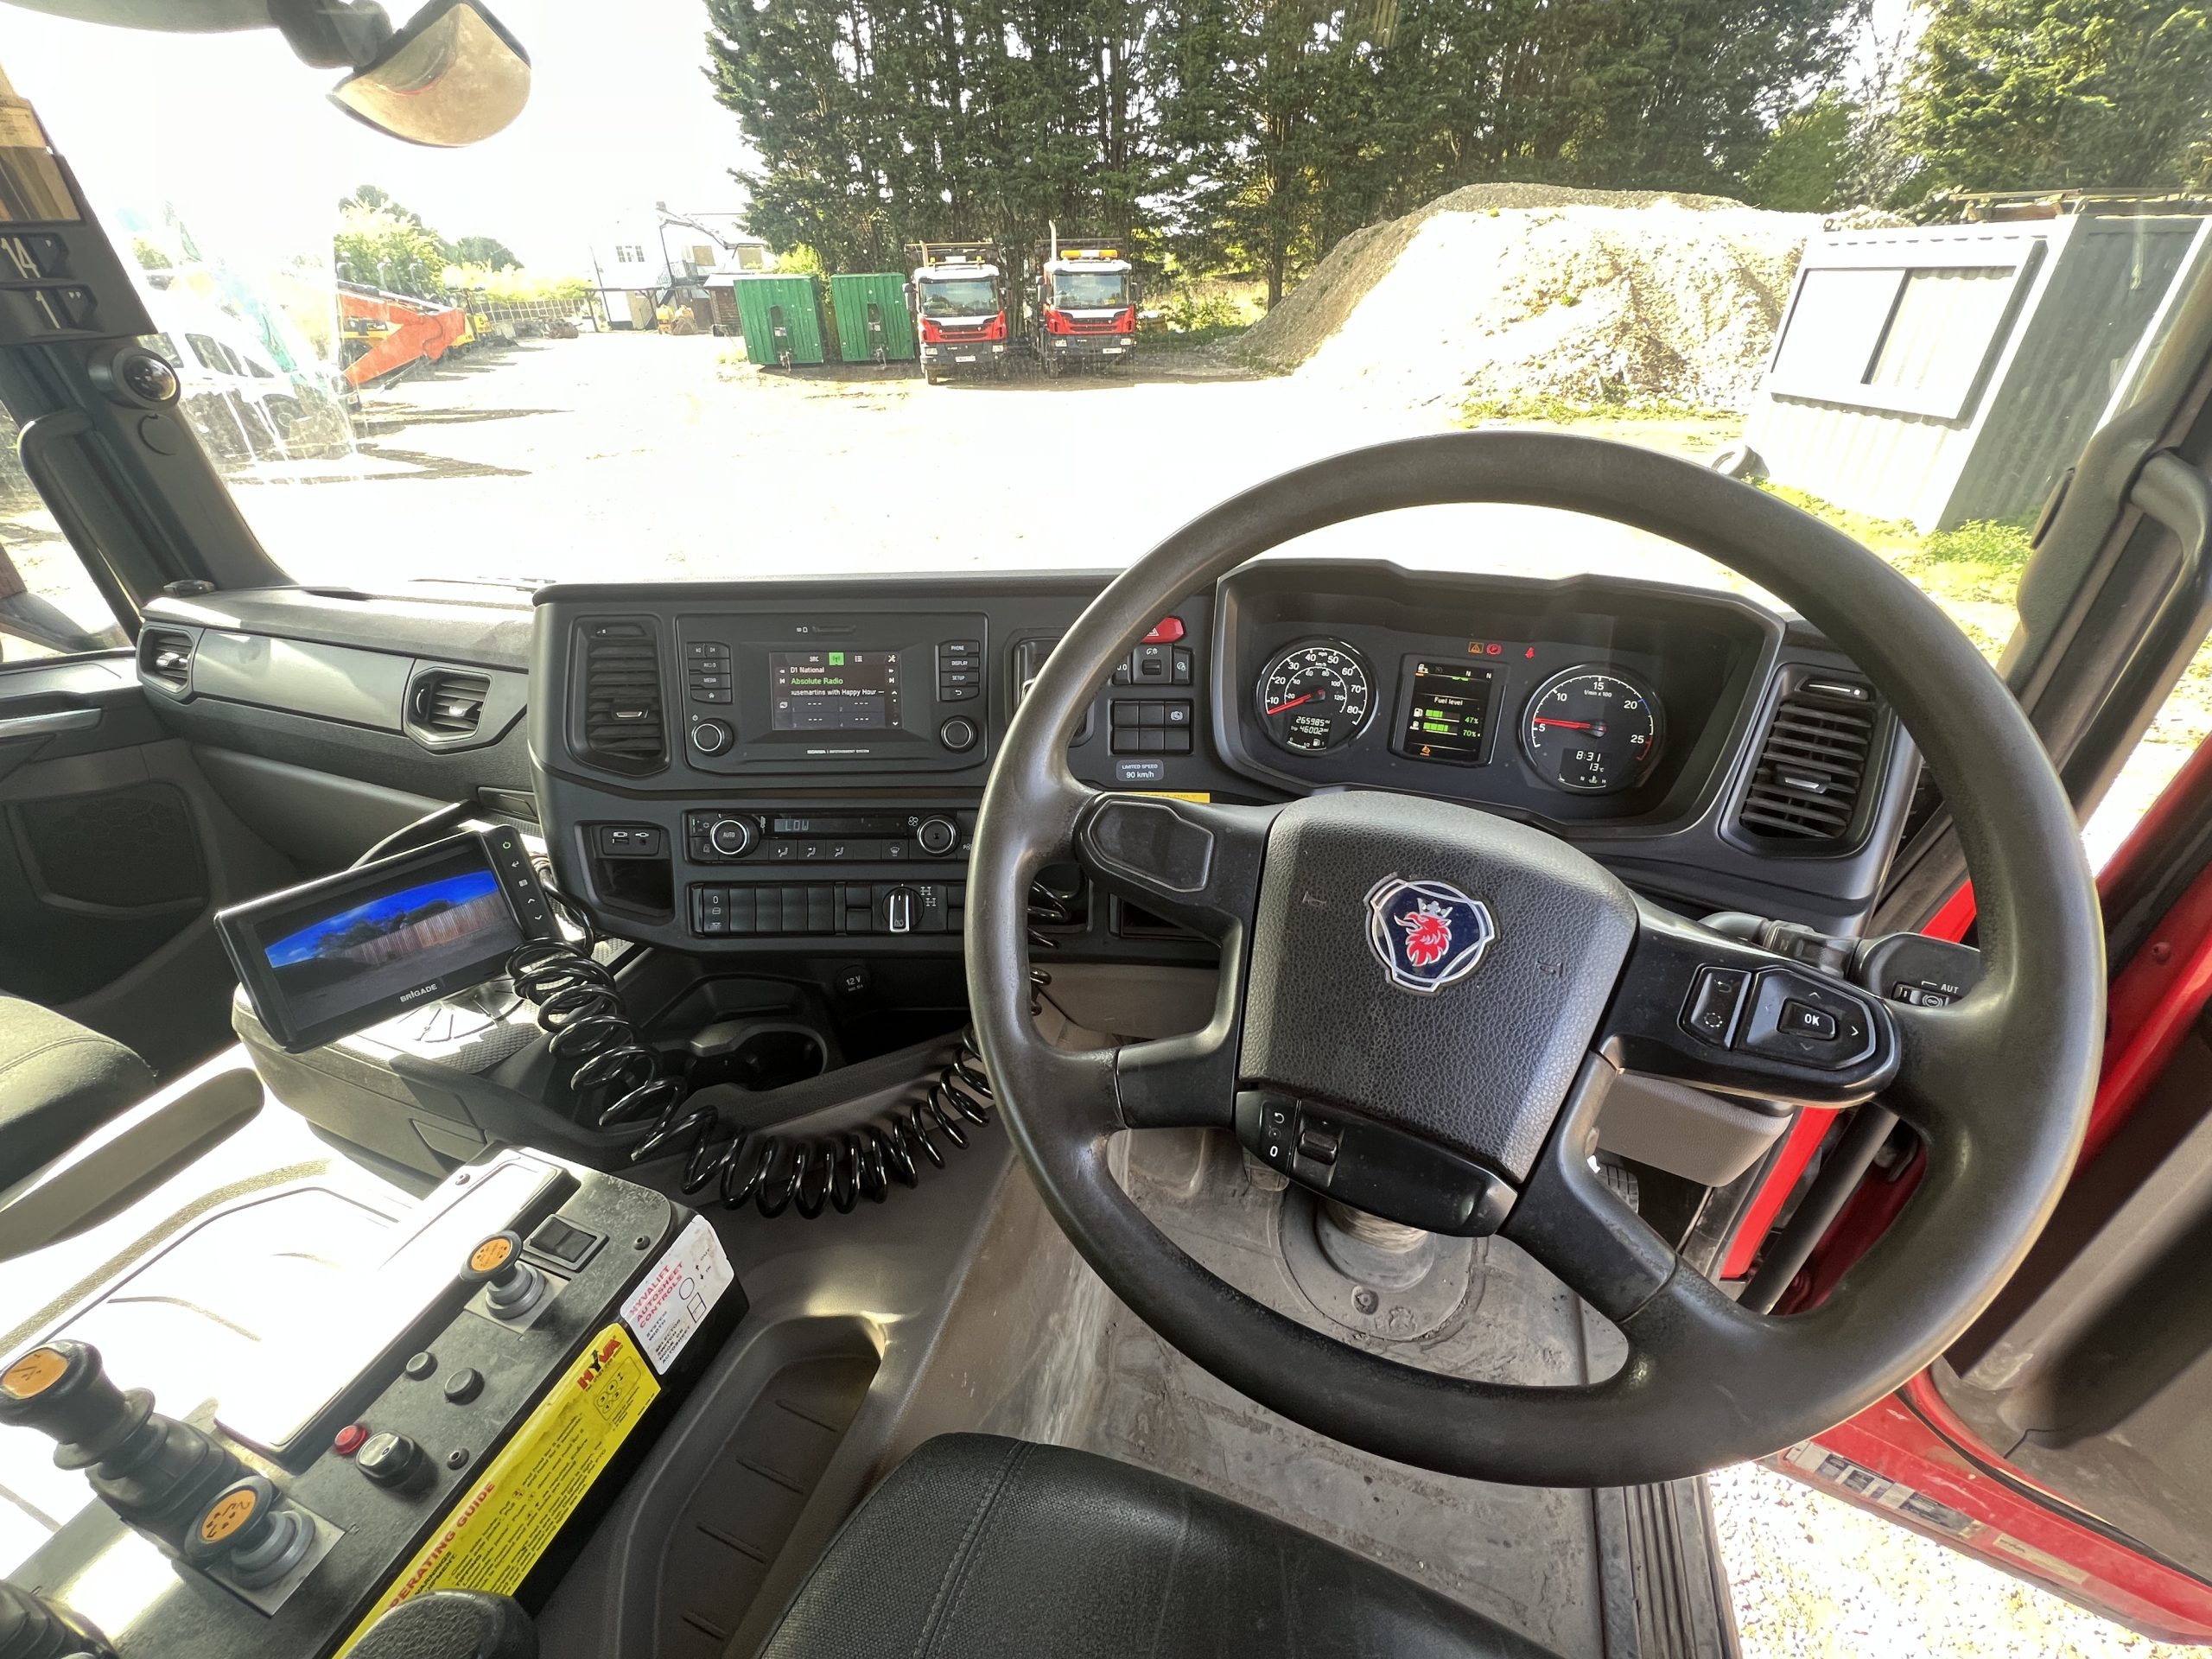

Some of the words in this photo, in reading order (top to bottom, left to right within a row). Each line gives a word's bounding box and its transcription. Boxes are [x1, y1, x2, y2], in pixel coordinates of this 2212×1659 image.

[1624, 700, 1637, 709] 20
[1296, 716, 1325, 726] 265985
[1576, 751, 1600, 762] 8:31
[400, 983, 438, 1003] BRIGADE
[1805, 1014, 1820, 1026] OK
[630, 1265, 670, 1314] HYVALIFT
[637, 1262, 683, 1322] AUTOSHEET
[640, 1274, 683, 1328] CONTROLS
[649, 1319, 665, 1342] WIDTH
[577, 1340, 622, 1390] HYVA
[386, 1529, 456, 1611] PERATING
[456, 1482, 495, 1528] GUIDE
